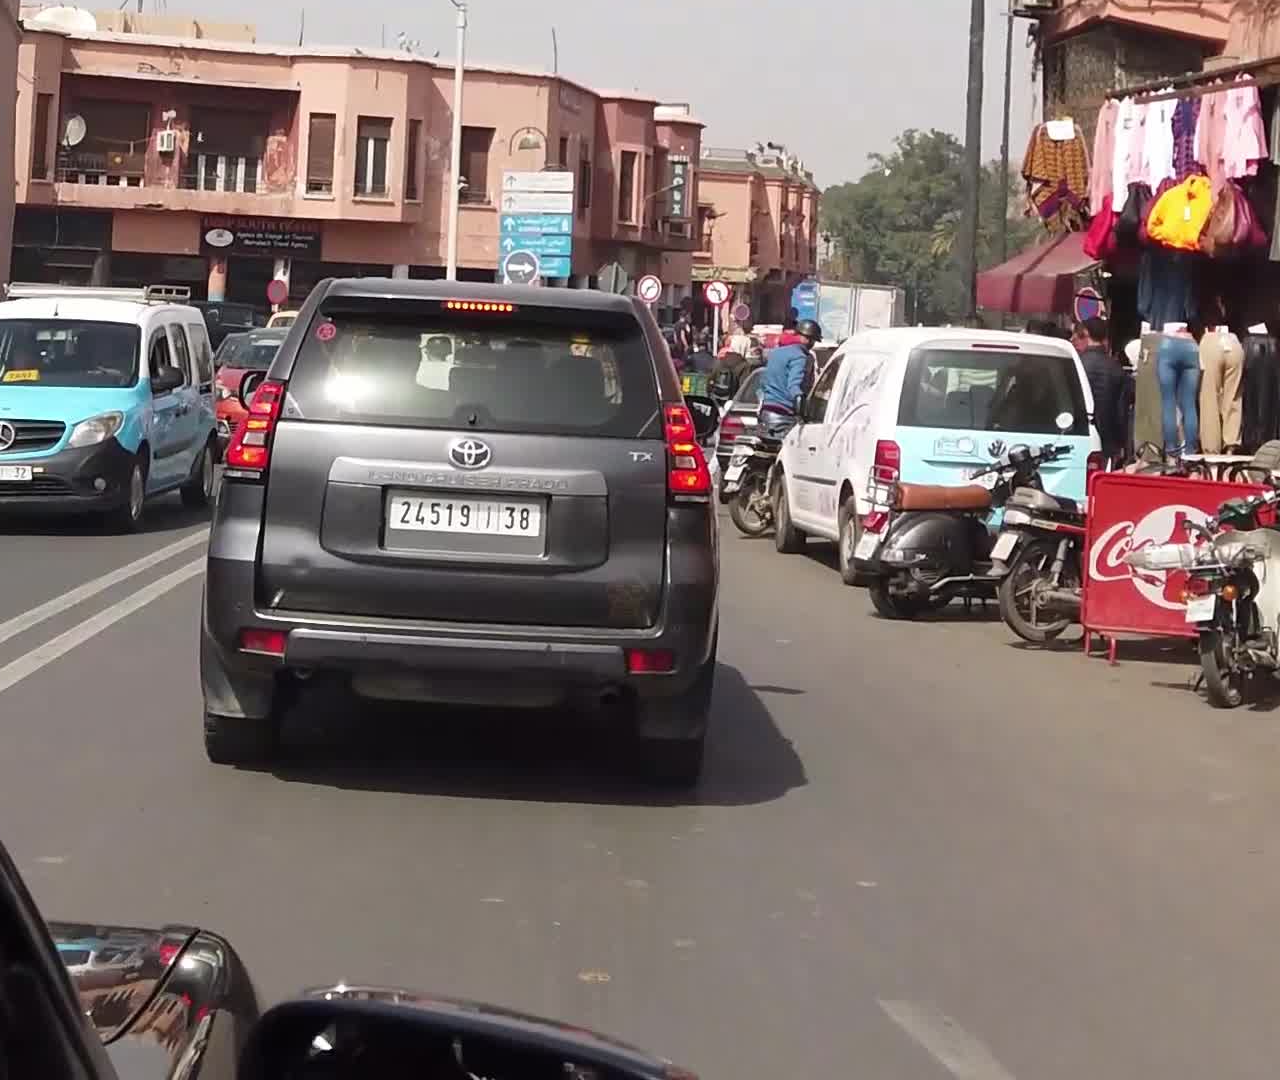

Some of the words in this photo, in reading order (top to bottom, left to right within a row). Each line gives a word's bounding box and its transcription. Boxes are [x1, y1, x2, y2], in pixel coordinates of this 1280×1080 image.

[628, 450, 654, 463] TX
[400, 501, 471, 527] 24519
[504, 506, 530, 530] 38
